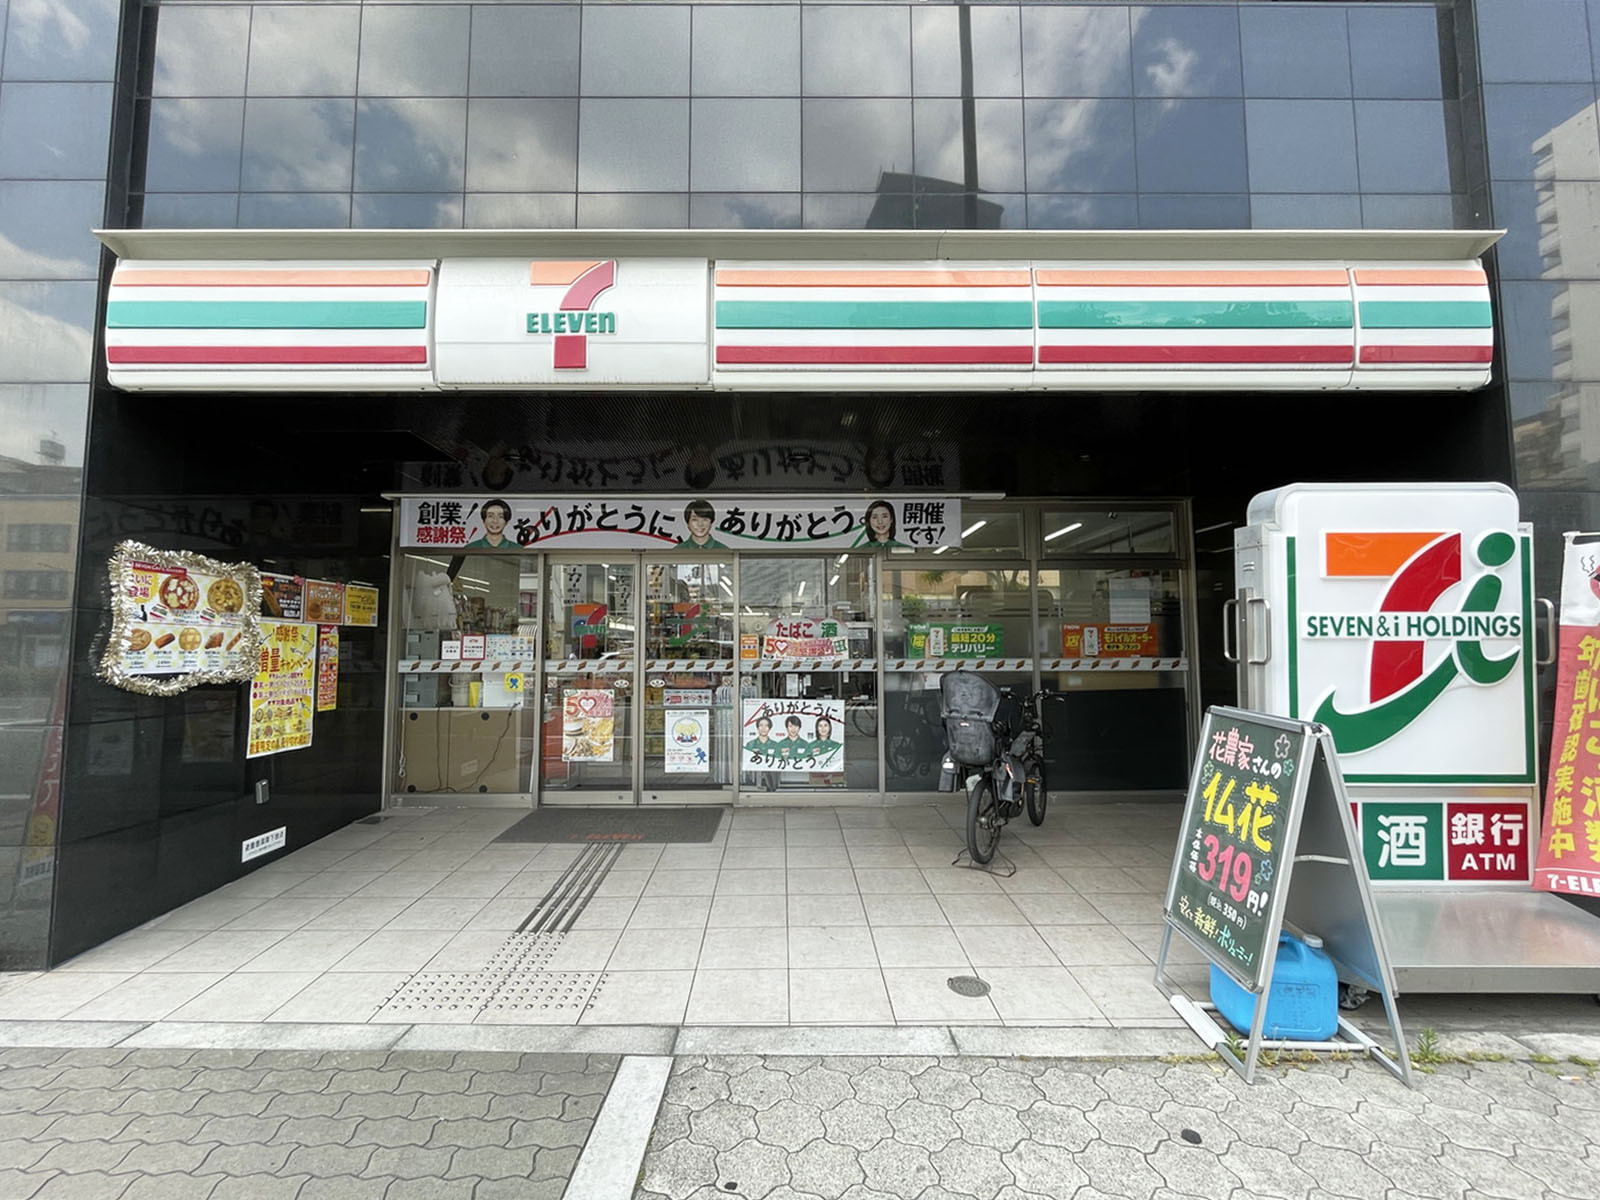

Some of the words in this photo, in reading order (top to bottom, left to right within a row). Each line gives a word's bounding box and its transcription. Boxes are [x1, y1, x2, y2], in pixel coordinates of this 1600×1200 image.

[417, 501, 479, 526] 創業!
[513, 502, 684, 545] ありがとうに、
[903, 502, 945, 525] 開催
[416, 526, 478, 544] 感謝祭!
[903, 526, 946, 545] です!
[776, 622, 814, 638] たばこ
[821, 622, 838, 638] 酒
[1406, 615, 1522, 638] HOLDINGS
[951, 643, 995, 653] デリバリー
[1209, 727, 1282, 779] 花農家さんの
[1203, 771, 1278, 853] 仏花
[1451, 812, 1524, 846] 銀行
[1377, 814, 1429, 868] 酒
[1461, 853, 1516, 871] ATM
